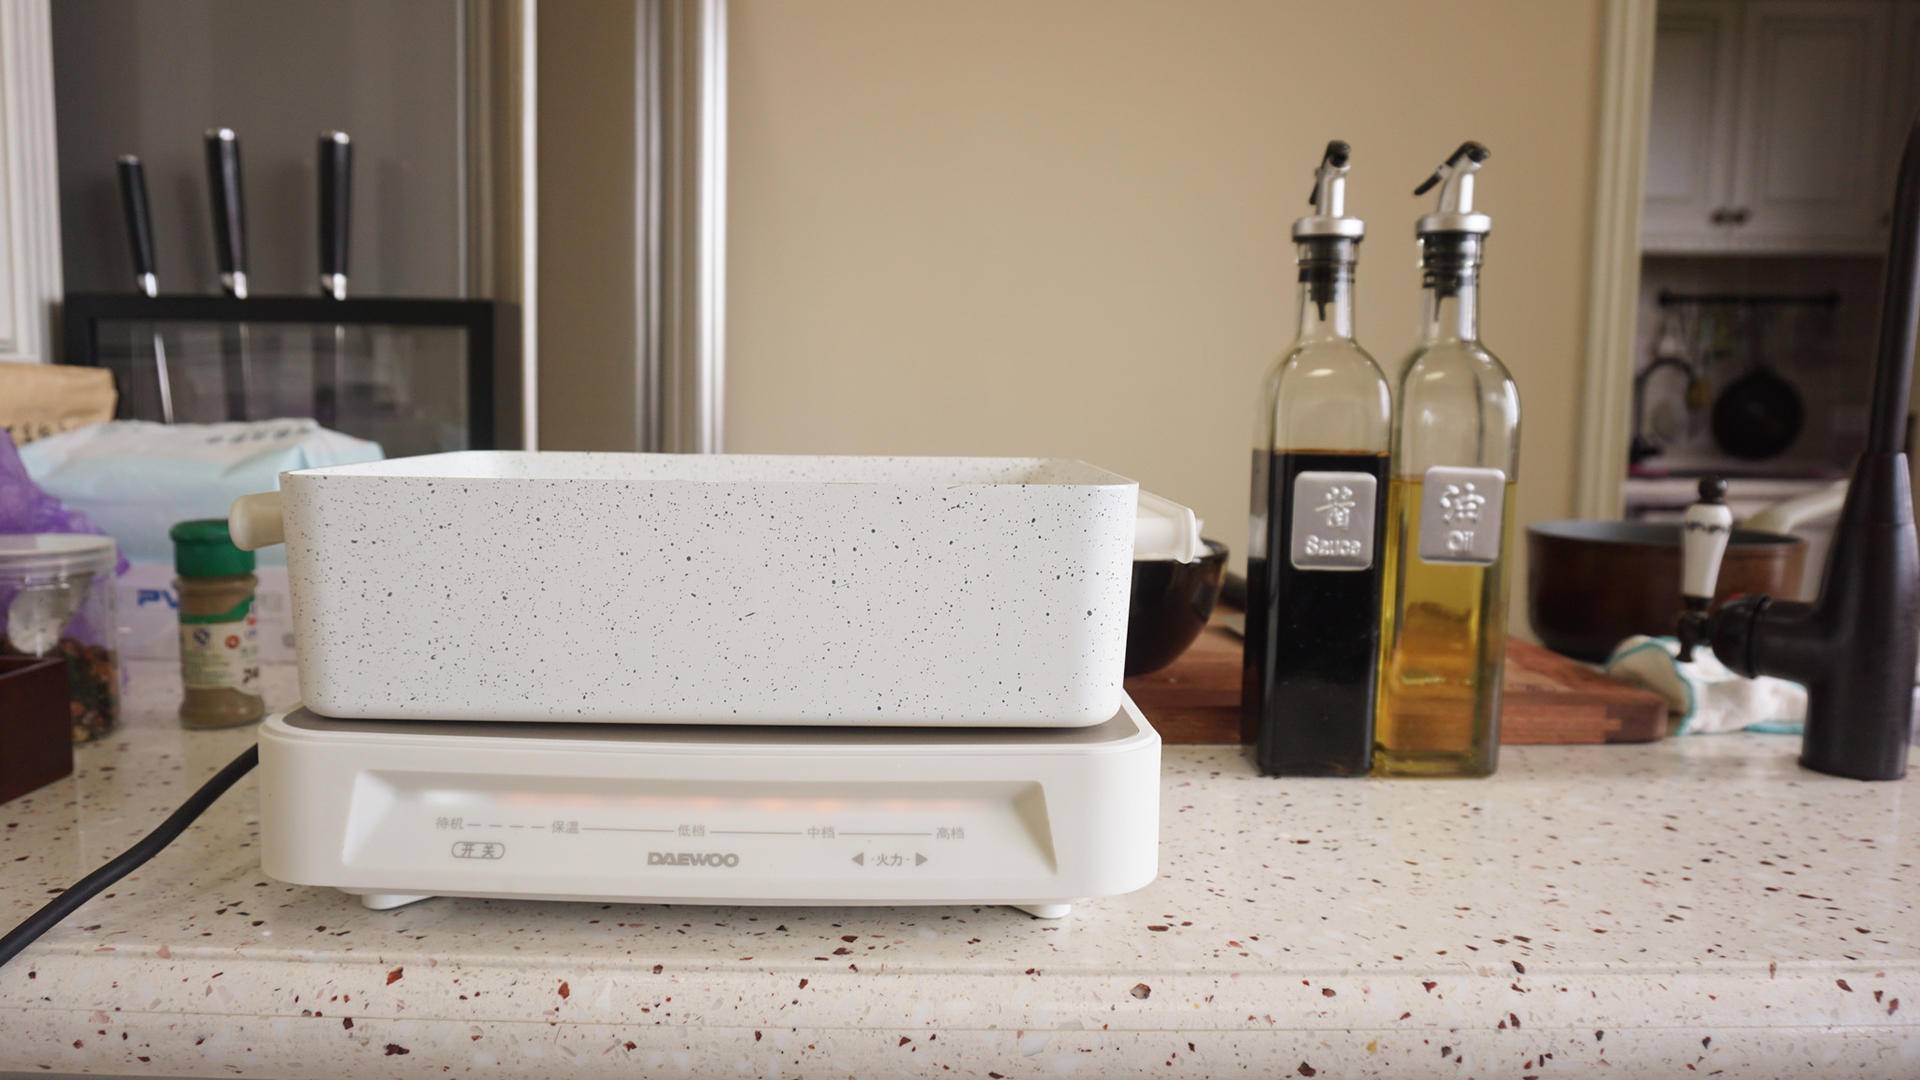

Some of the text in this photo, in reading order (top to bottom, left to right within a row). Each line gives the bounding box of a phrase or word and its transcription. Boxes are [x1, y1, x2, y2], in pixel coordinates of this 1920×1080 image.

[1440, 482, 1486, 524] 油
[1305, 535, 1361, 556] Sauce
[1447, 530, 1475, 551] Oil
[435, 816, 965, 840] 待机 保温 低档 中档 高档
[647, 851, 740, 868] DAEWOO
[876, 853, 903, 867] 火力
